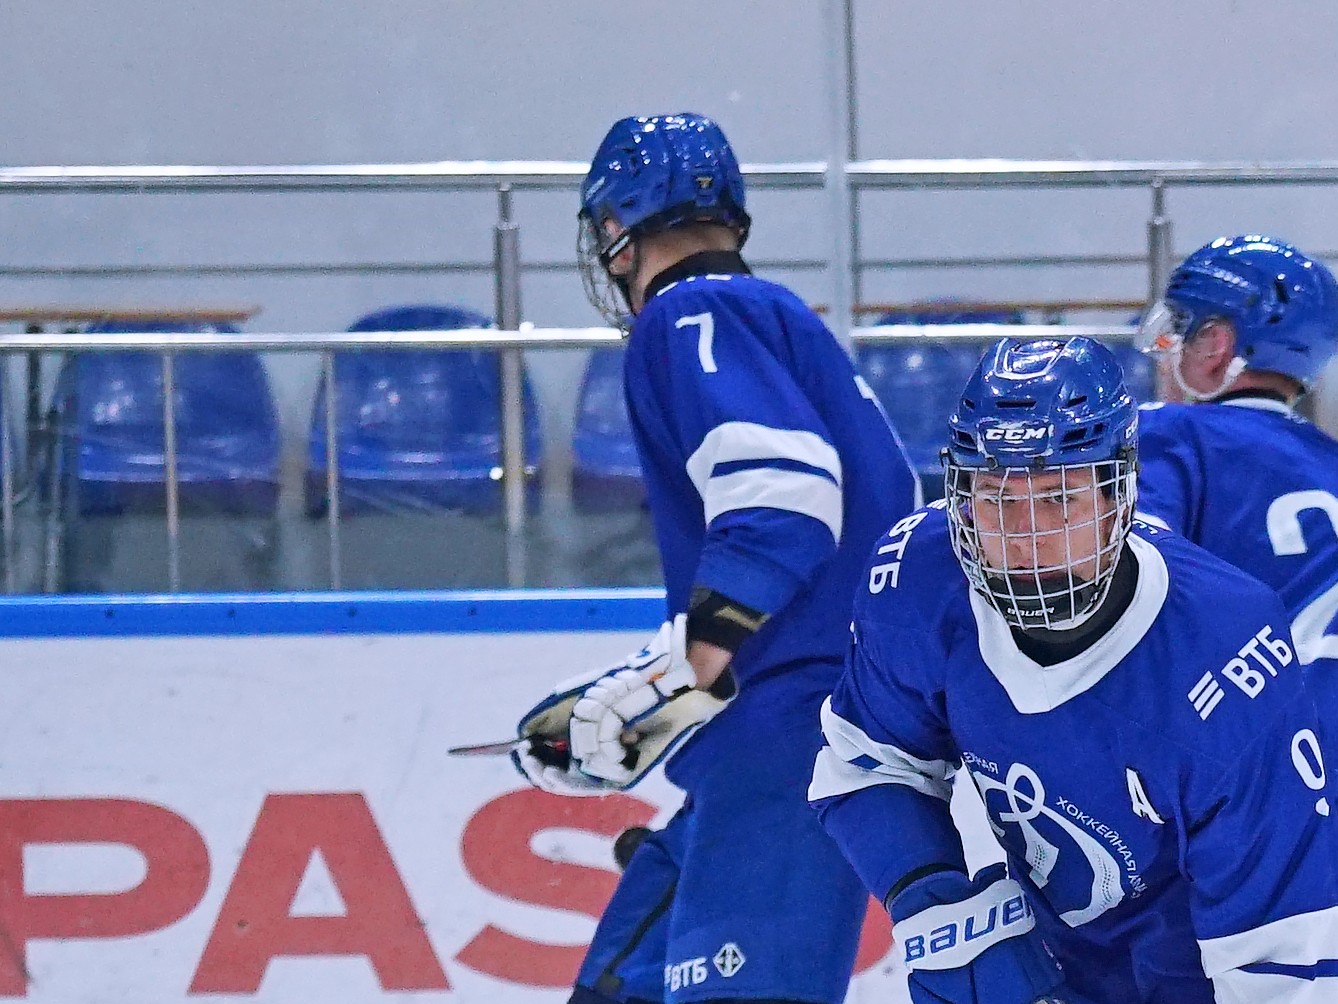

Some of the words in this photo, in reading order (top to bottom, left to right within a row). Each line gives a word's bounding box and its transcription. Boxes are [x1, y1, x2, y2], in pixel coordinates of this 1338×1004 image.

[675, 312, 714, 374] 7
[985, 427, 1047, 440] CCM
[869, 511, 929, 594] ВТБ
[1220, 624, 1293, 699] ВТБ
[1055, 796, 1137, 872] ХОККЕЙНАЯ
